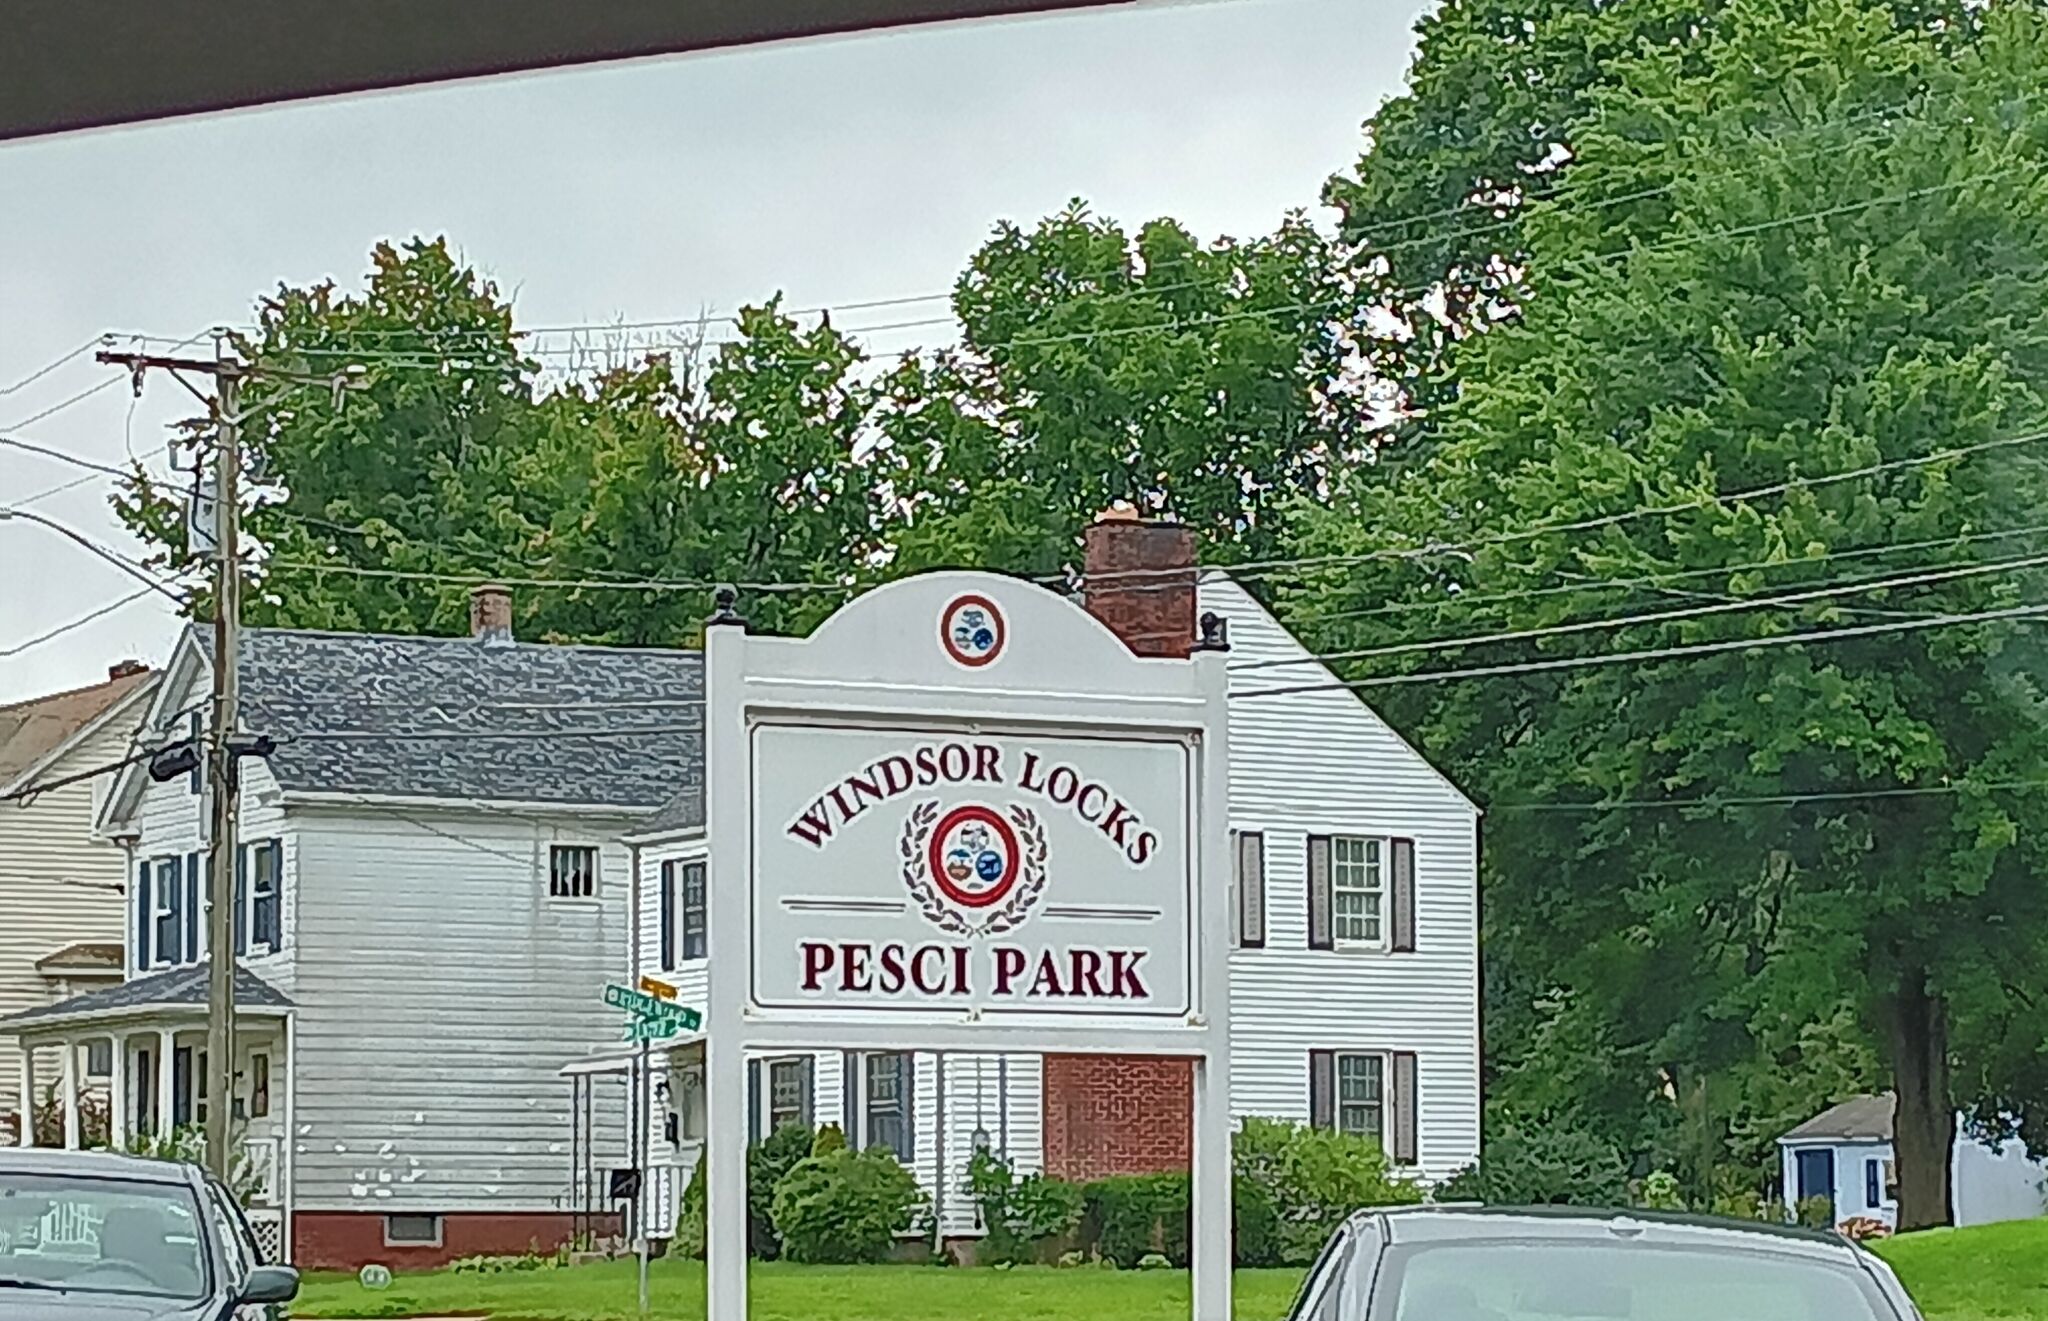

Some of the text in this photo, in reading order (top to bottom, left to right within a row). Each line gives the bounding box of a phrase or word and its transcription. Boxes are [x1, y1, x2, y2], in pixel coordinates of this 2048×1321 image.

[787, 744, 1157, 865] WINDSOR LOCKS
[801, 943, 1149, 997] PESCI PARK
